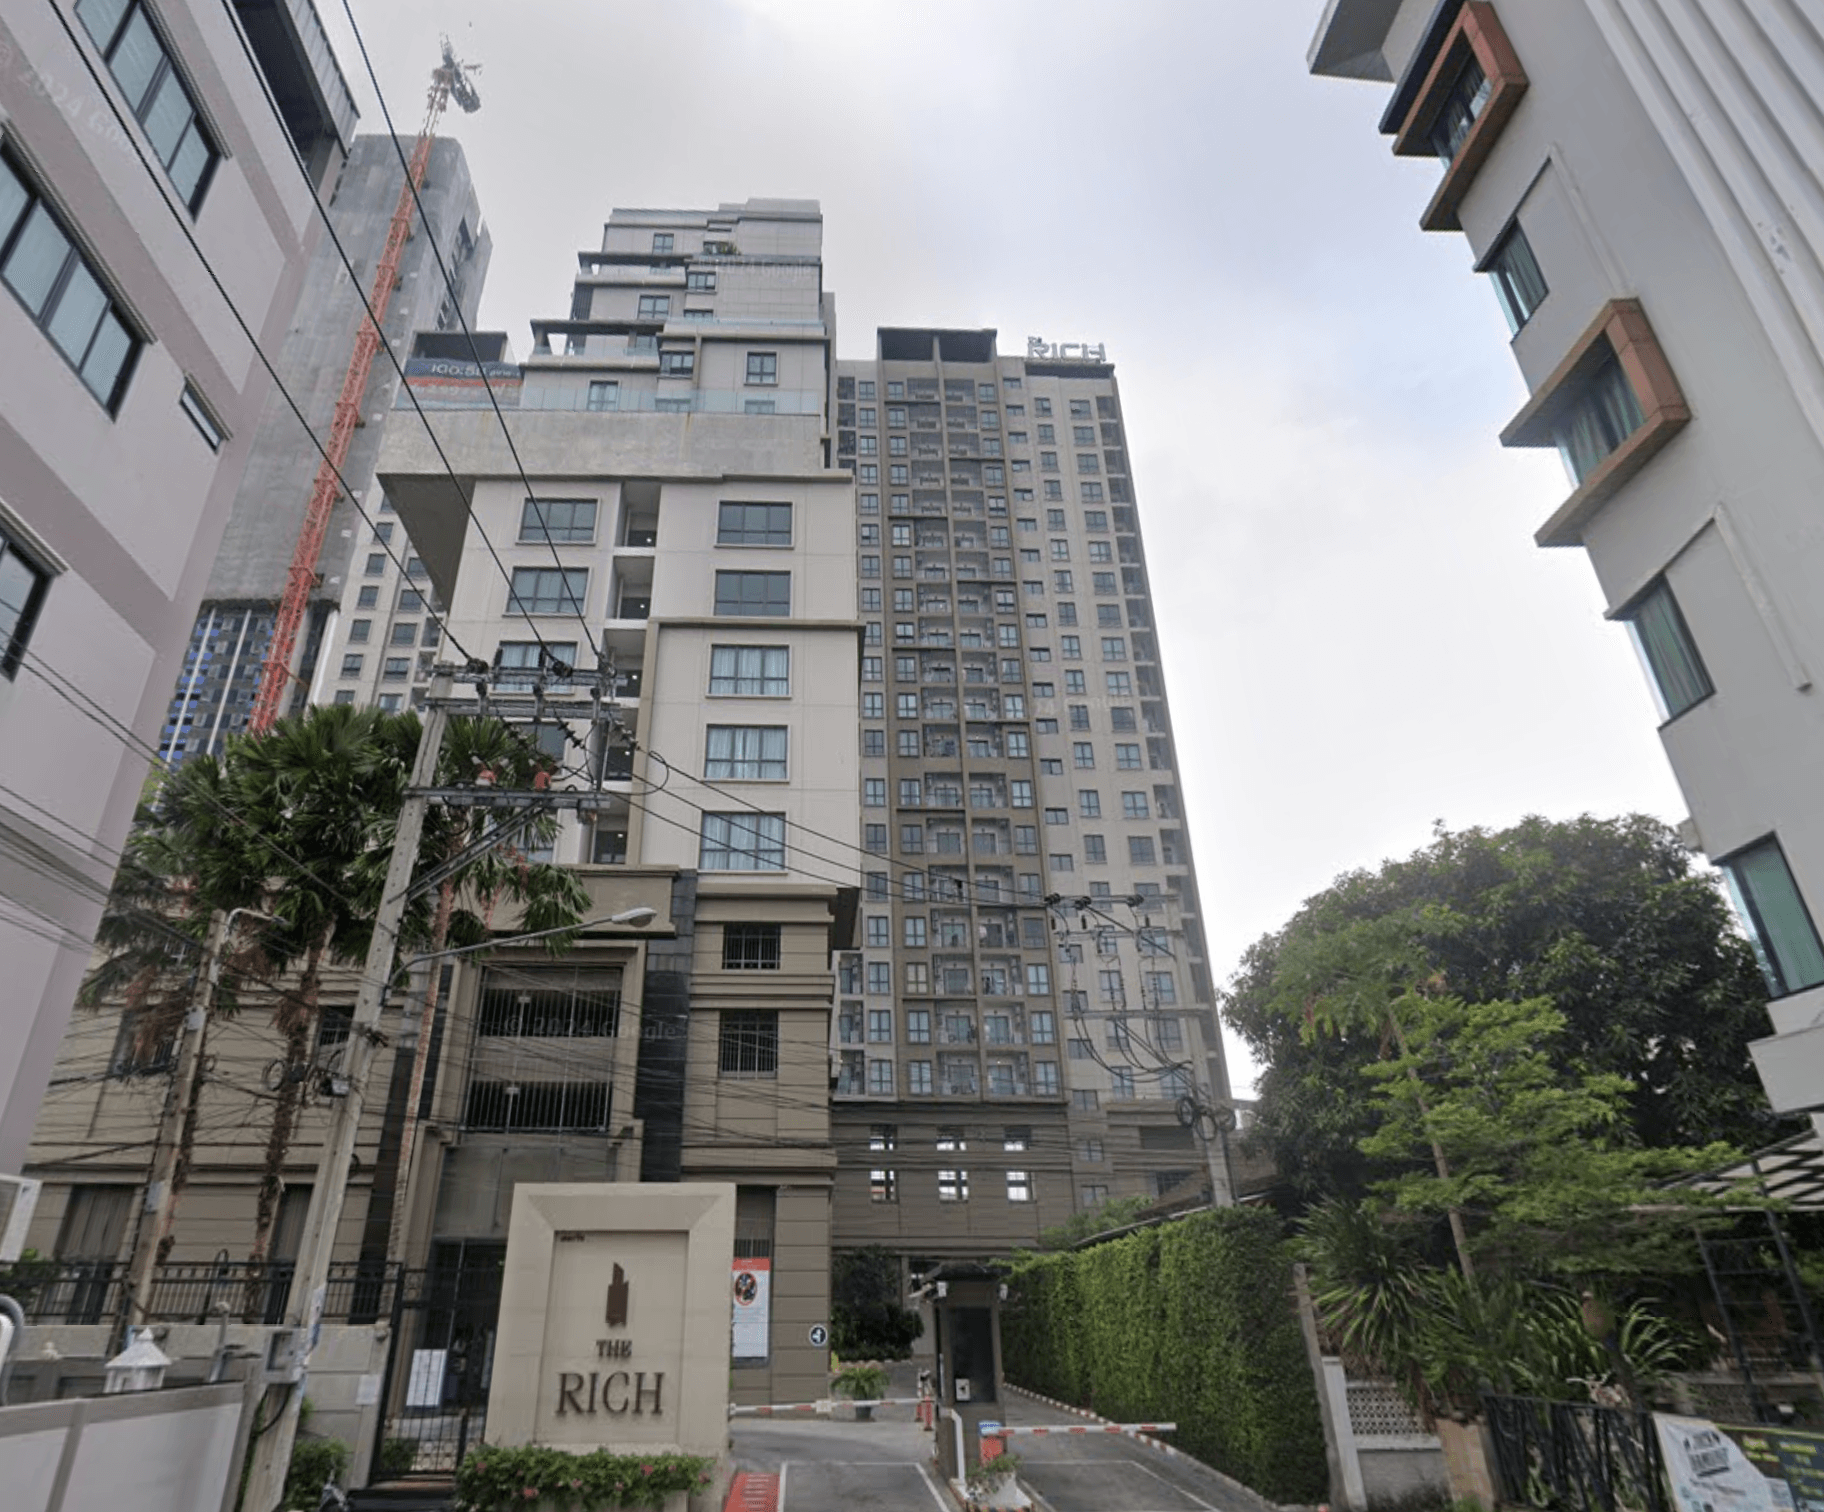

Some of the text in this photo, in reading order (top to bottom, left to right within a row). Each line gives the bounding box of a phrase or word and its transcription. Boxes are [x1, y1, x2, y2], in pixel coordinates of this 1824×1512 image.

[1028, 343, 1107, 362] RICH
[596, 1339, 633, 1359] THE
[555, 1371, 666, 1417] RICH
